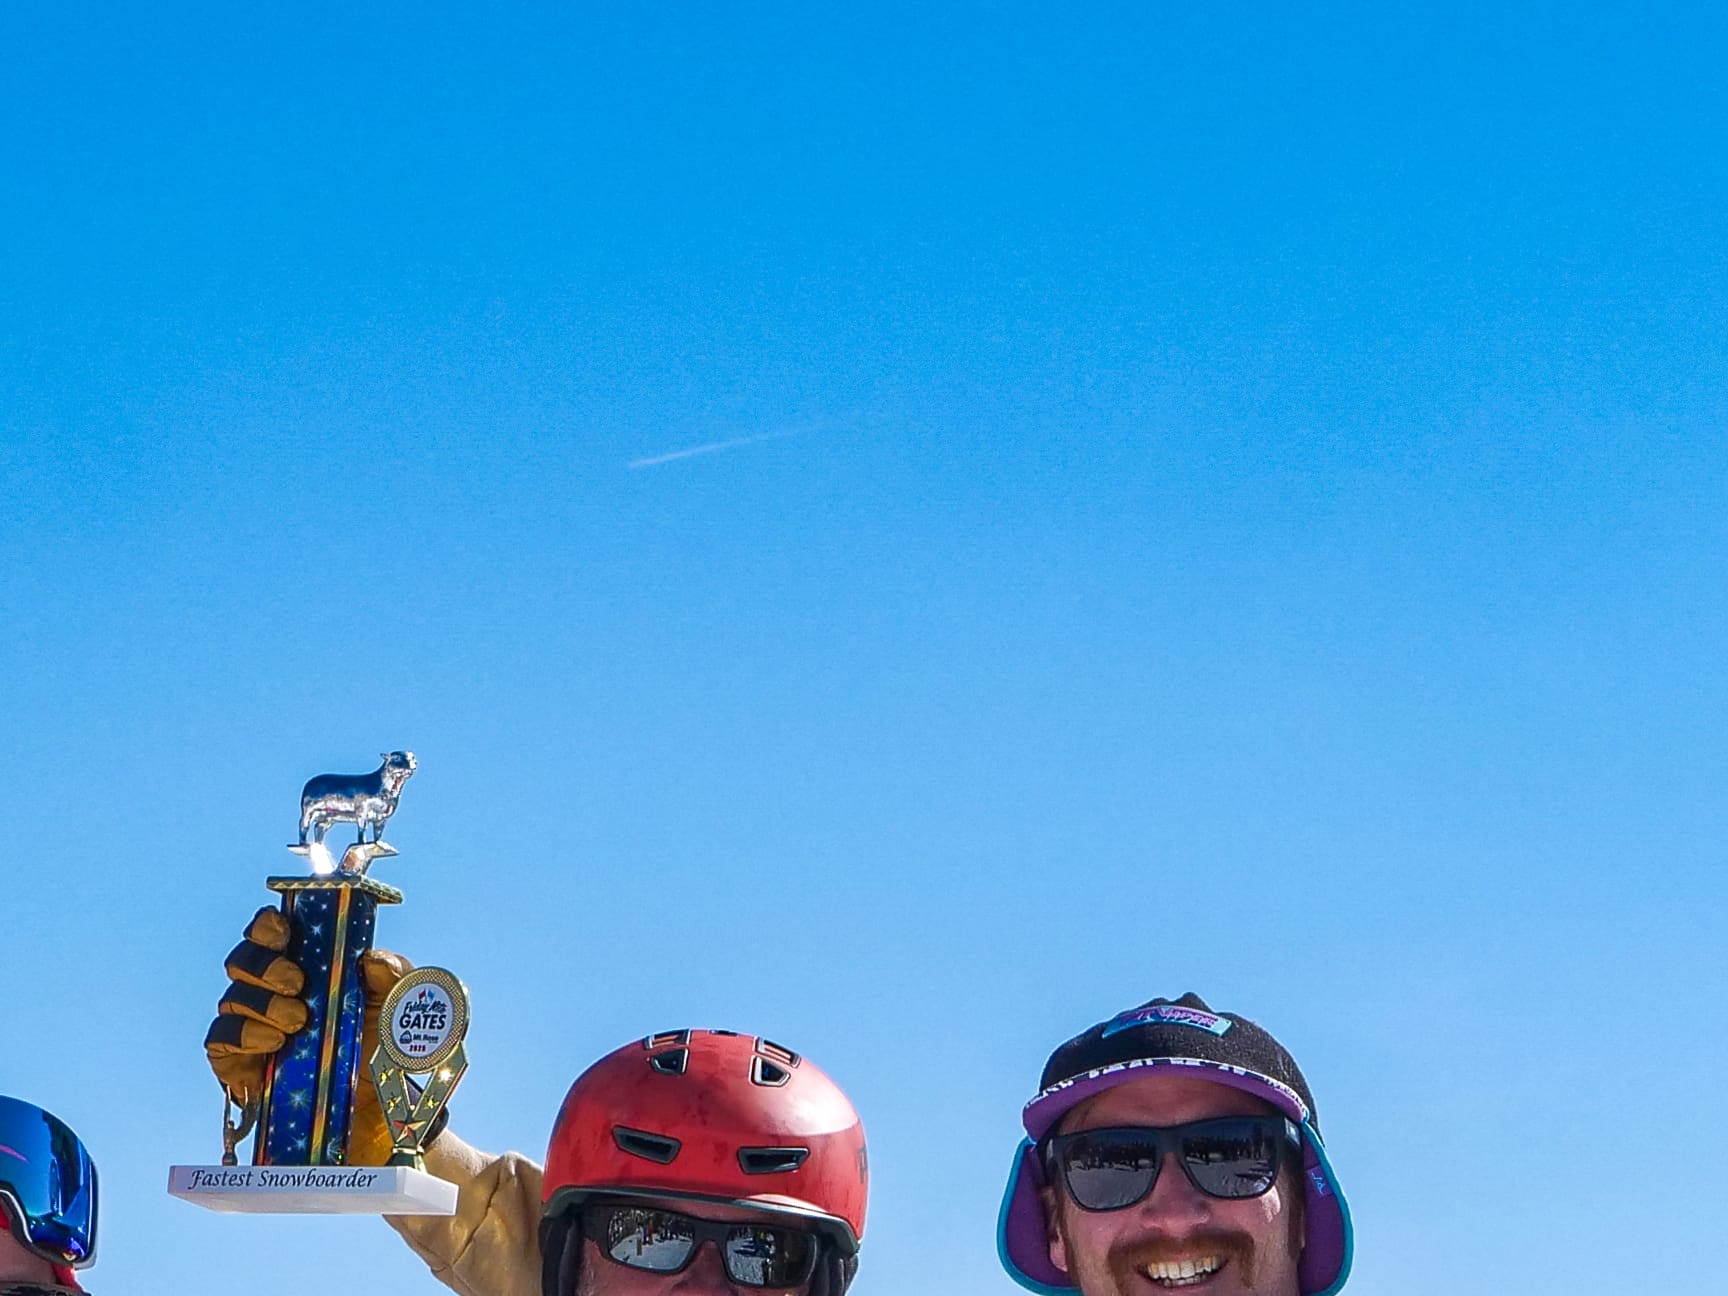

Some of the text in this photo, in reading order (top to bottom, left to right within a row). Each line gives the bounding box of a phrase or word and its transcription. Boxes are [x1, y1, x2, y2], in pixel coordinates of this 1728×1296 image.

[399, 1013, 447, 1030] GATES
[188, 1168, 378, 1189] Fastest Snowboarder
